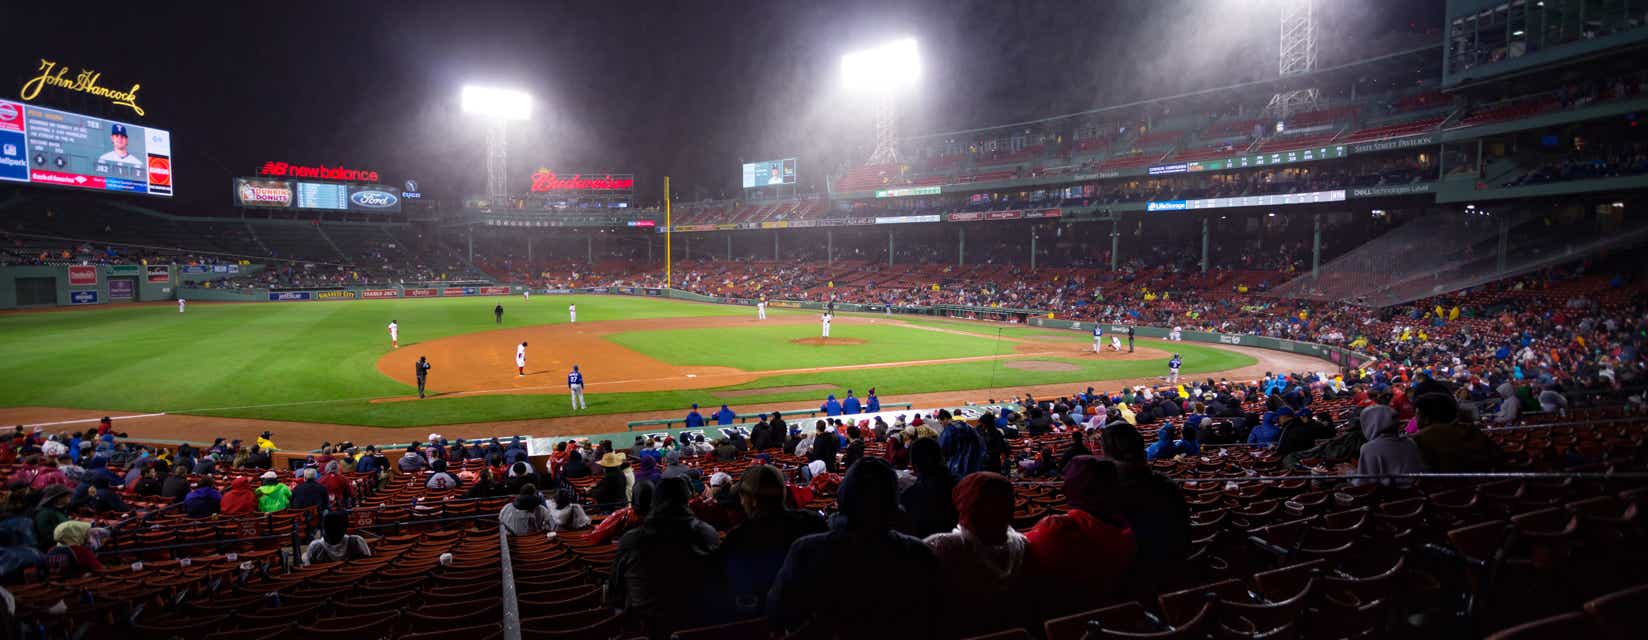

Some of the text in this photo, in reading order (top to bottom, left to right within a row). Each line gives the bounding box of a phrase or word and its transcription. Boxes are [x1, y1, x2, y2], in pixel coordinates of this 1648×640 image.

[21, 58, 144, 116] John Hancock
[320, 165, 378, 181] balance
[359, 193, 388, 205] Ford
